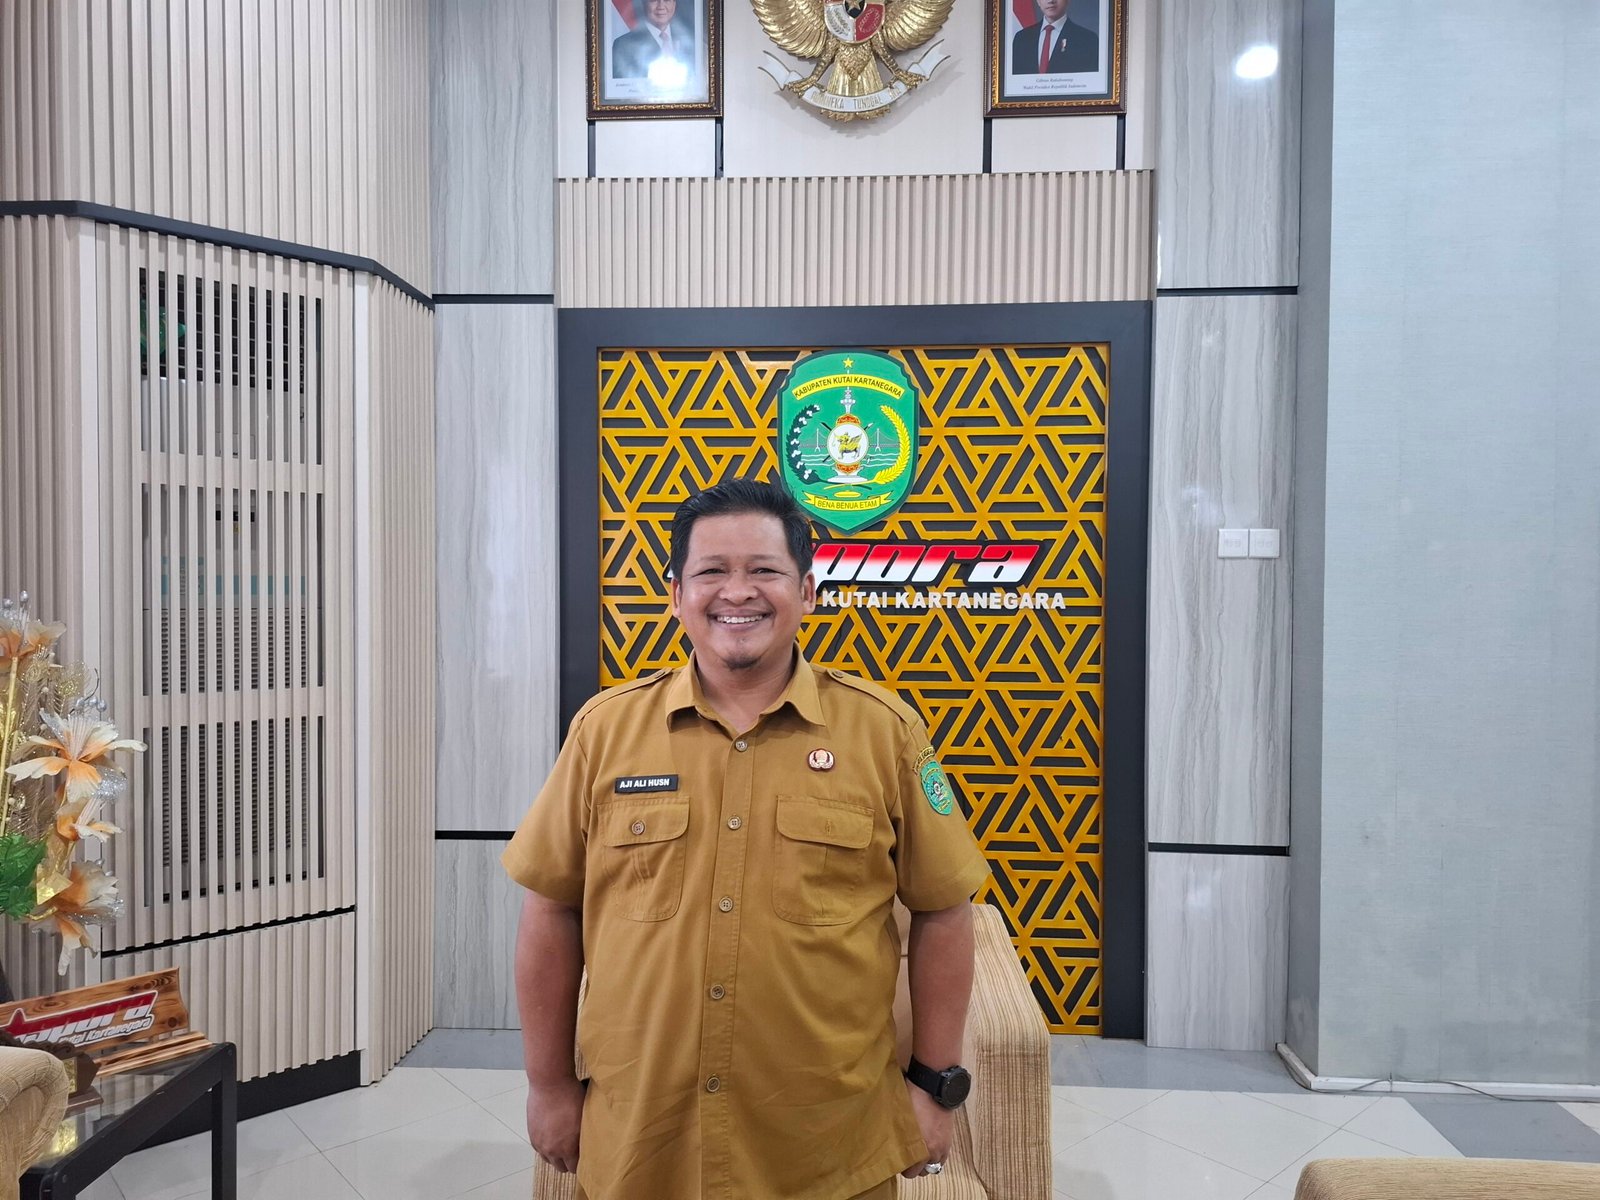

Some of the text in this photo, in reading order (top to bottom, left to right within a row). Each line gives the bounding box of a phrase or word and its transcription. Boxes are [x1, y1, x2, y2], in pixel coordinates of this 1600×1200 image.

[794, 376, 902, 397] KABUPATEN KUTAI KARTANEGARA
[817, 499, 878, 510] BENA BENUA ETAM
[812, 543, 1040, 593] pora
[821, 590, 1067, 610] KUTAI KARTANEGARA
[619, 778, 670, 789] AJI ALI HUSN
